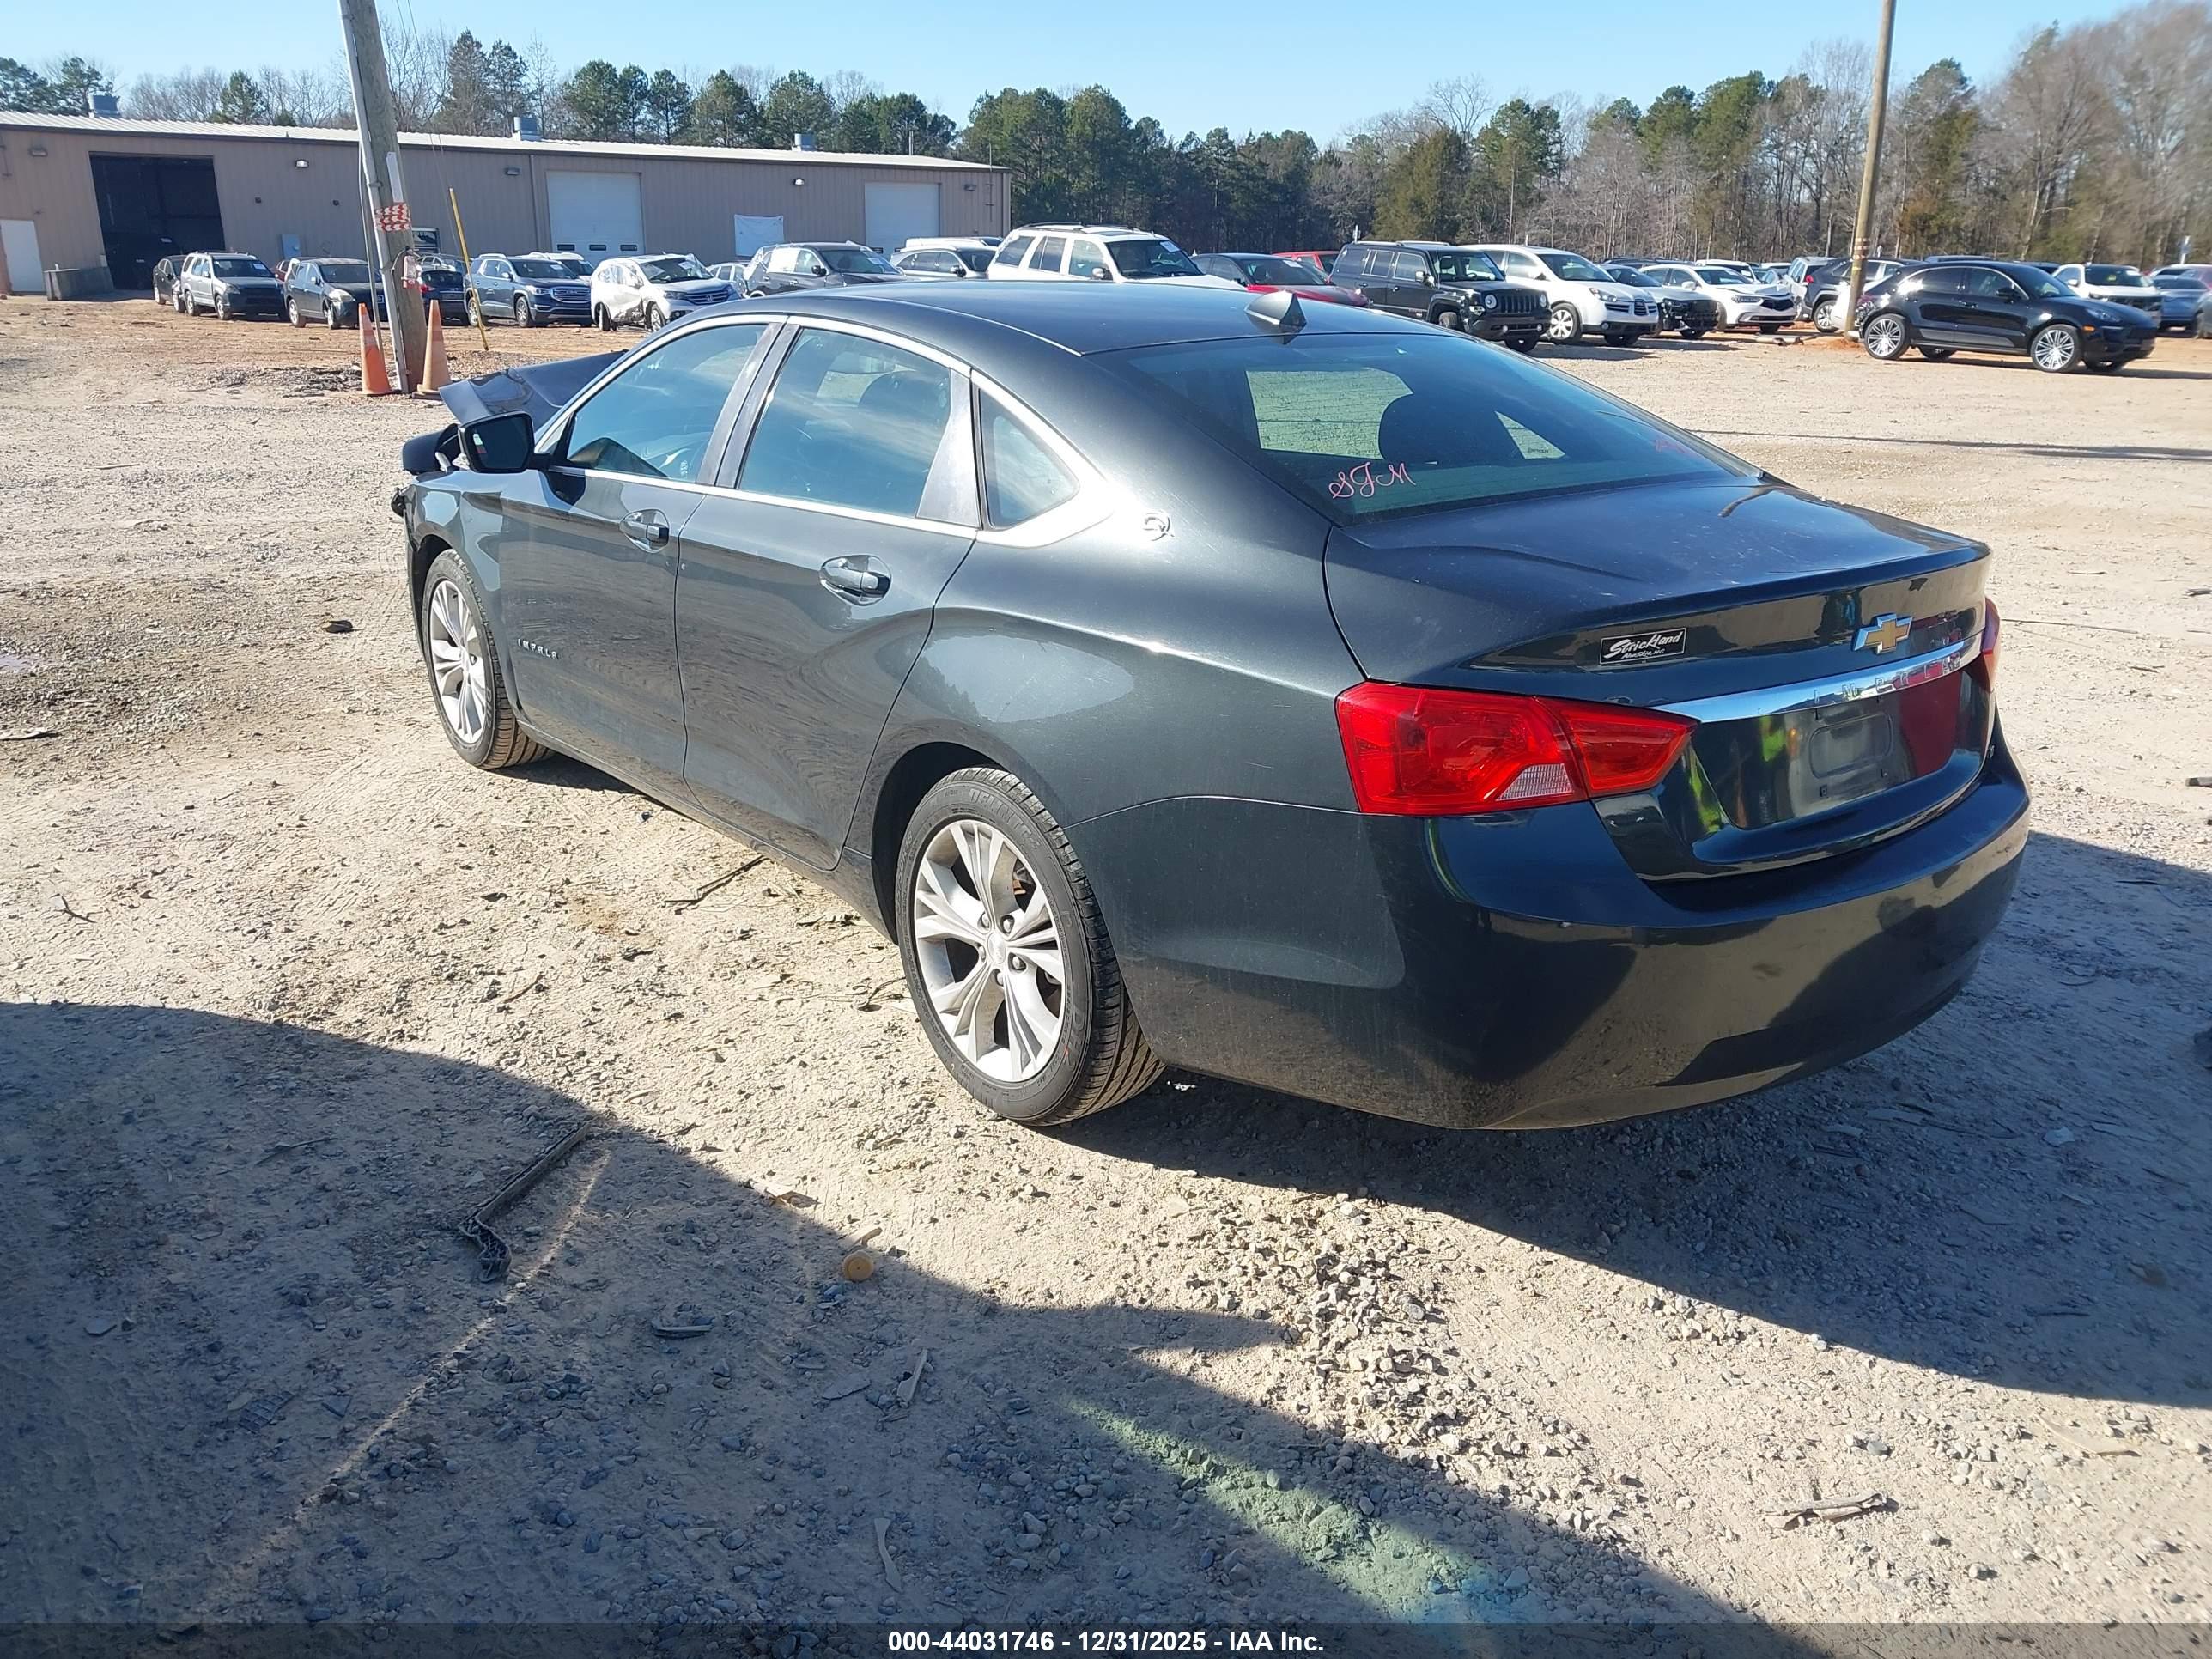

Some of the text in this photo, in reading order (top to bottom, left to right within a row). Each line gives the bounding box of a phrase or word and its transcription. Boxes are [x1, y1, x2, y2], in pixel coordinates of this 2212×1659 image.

[517, 638, 558, 660] IMPALA
[1603, 631, 1684, 659] Strickland
[1814, 652, 1961, 704] IMPALA
